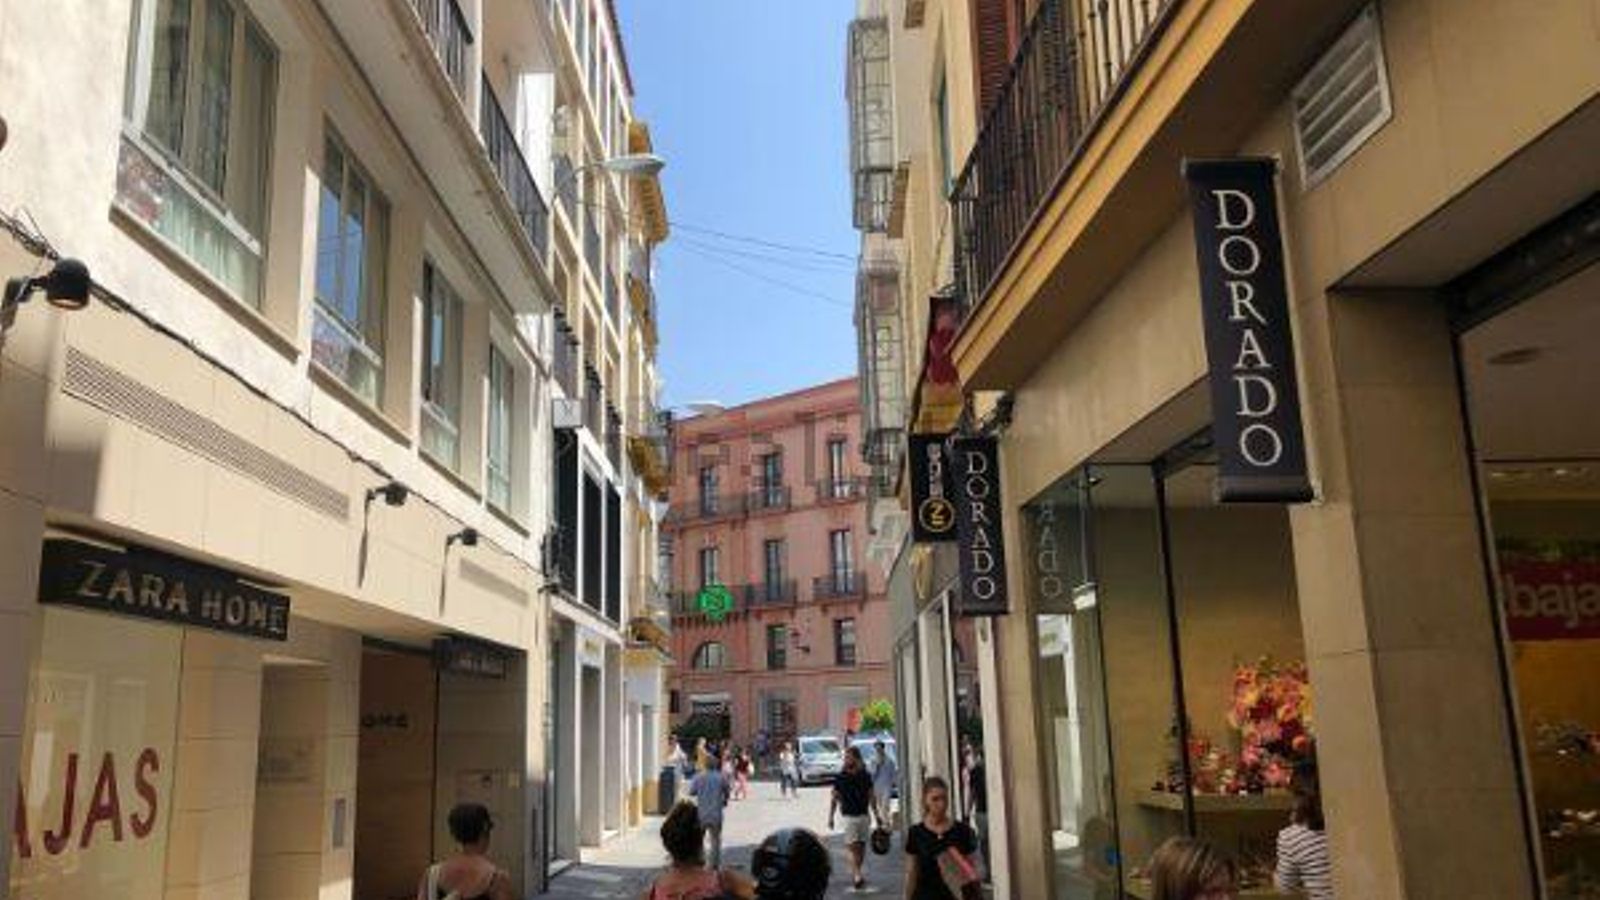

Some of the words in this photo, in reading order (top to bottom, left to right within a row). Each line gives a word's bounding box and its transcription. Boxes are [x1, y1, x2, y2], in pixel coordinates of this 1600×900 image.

[1211, 189, 1283, 467] DORADO
[77, 558, 189, 615] ZARA
[202, 588, 288, 635] HOME
[965, 450, 996, 601] DORADO
